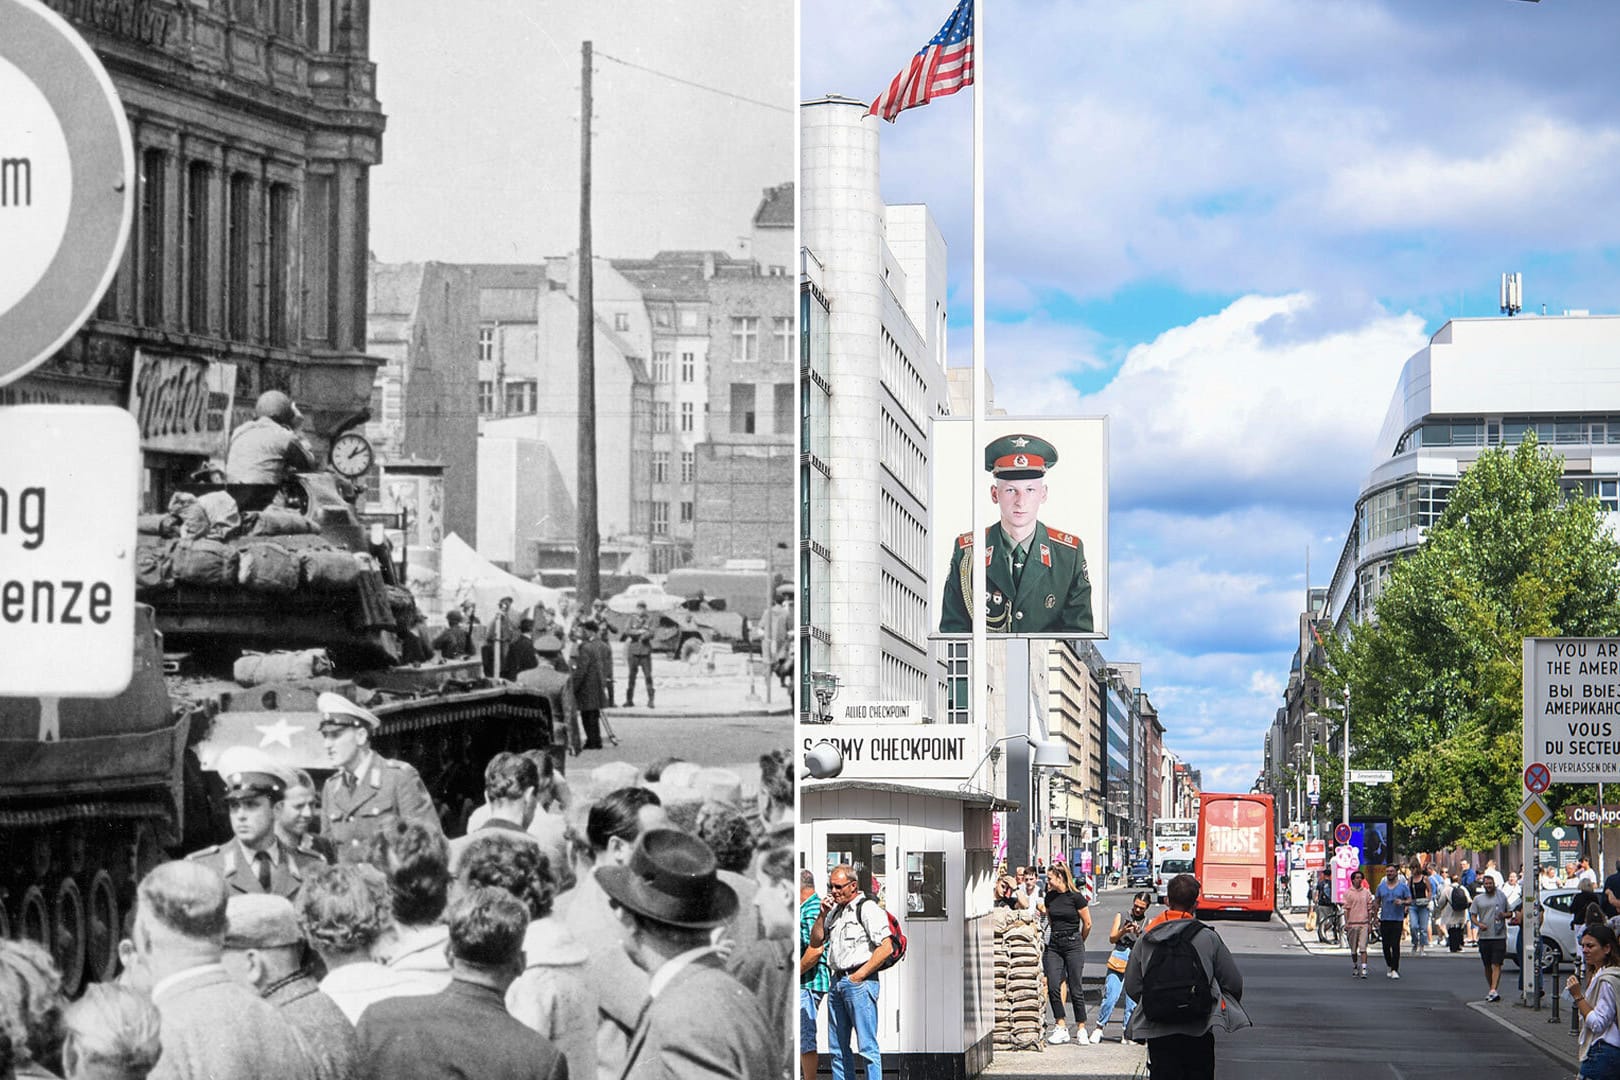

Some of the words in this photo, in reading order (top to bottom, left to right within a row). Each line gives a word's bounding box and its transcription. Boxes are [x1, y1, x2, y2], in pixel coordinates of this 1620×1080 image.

[2, 157, 31, 207] m
[1555, 643, 1586, 657] YOU
[1547, 661, 1571, 675] THE
[1579, 661, 1620, 675] AMER
[1549, 684, 1572, 698] ВЫ
[869, 705, 910, 718] CHECKPOINT
[1568, 722, 1612, 737] VOUS
[820, 738, 864, 761] MY
[871, 738, 966, 761] CHECKPOINT
[1545, 741, 1564, 755] DU
[1569, 741, 1620, 755] SECTEU
[1558, 762, 1601, 773] VERLASSEN
[1602, 762, 1617, 773] DEN
[1574, 808, 1620, 823] Chekpo
